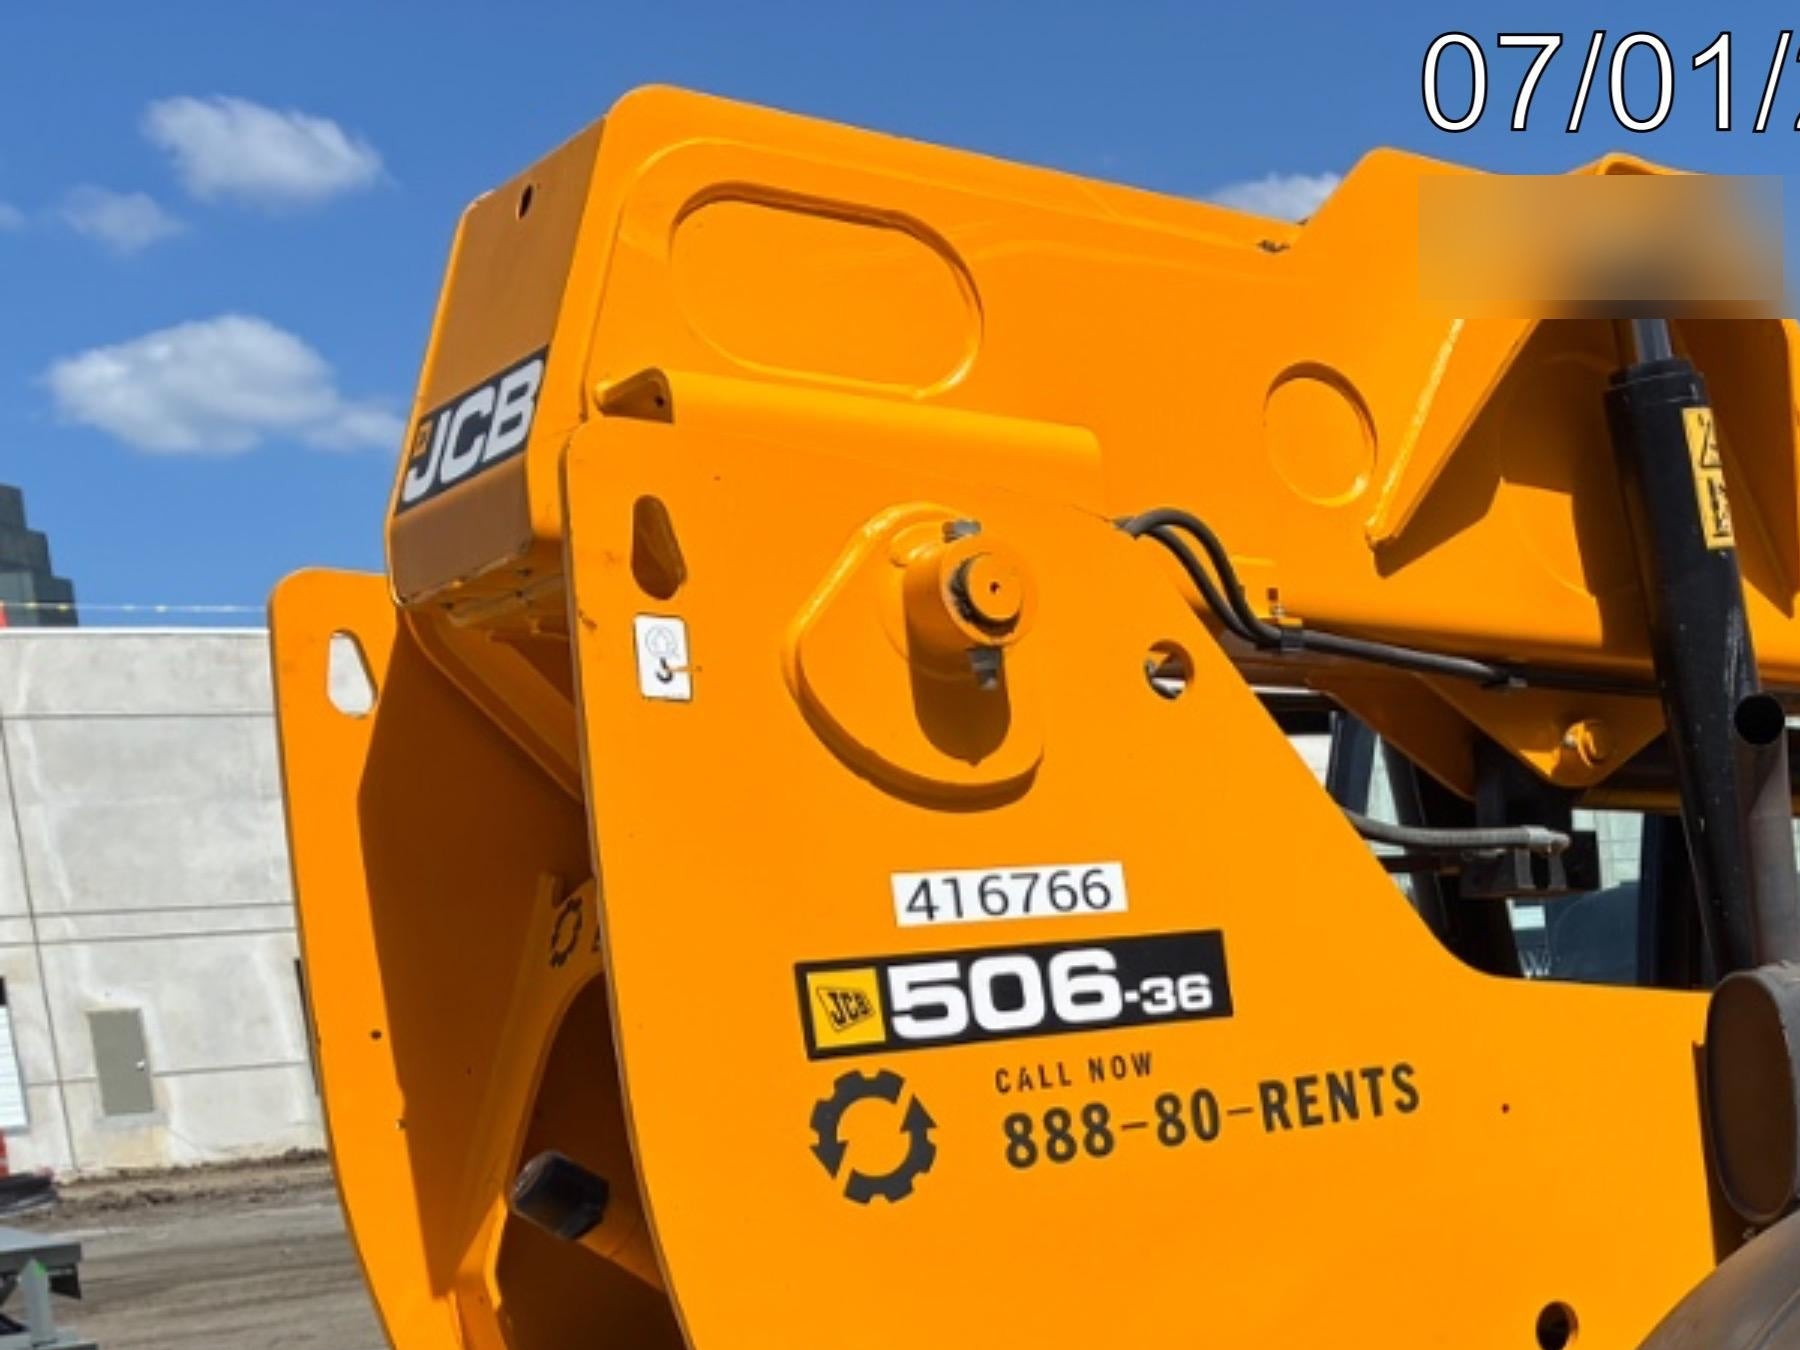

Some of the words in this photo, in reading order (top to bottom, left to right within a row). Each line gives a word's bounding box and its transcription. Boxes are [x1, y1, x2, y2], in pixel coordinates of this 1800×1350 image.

[402, 358, 546, 503] JCB
[904, 868, 1113, 923] 416766
[886, 947, 1214, 1040] 506-36
[994, 1063, 1072, 1094] CALL
[1088, 1051, 1154, 1081] NOW
